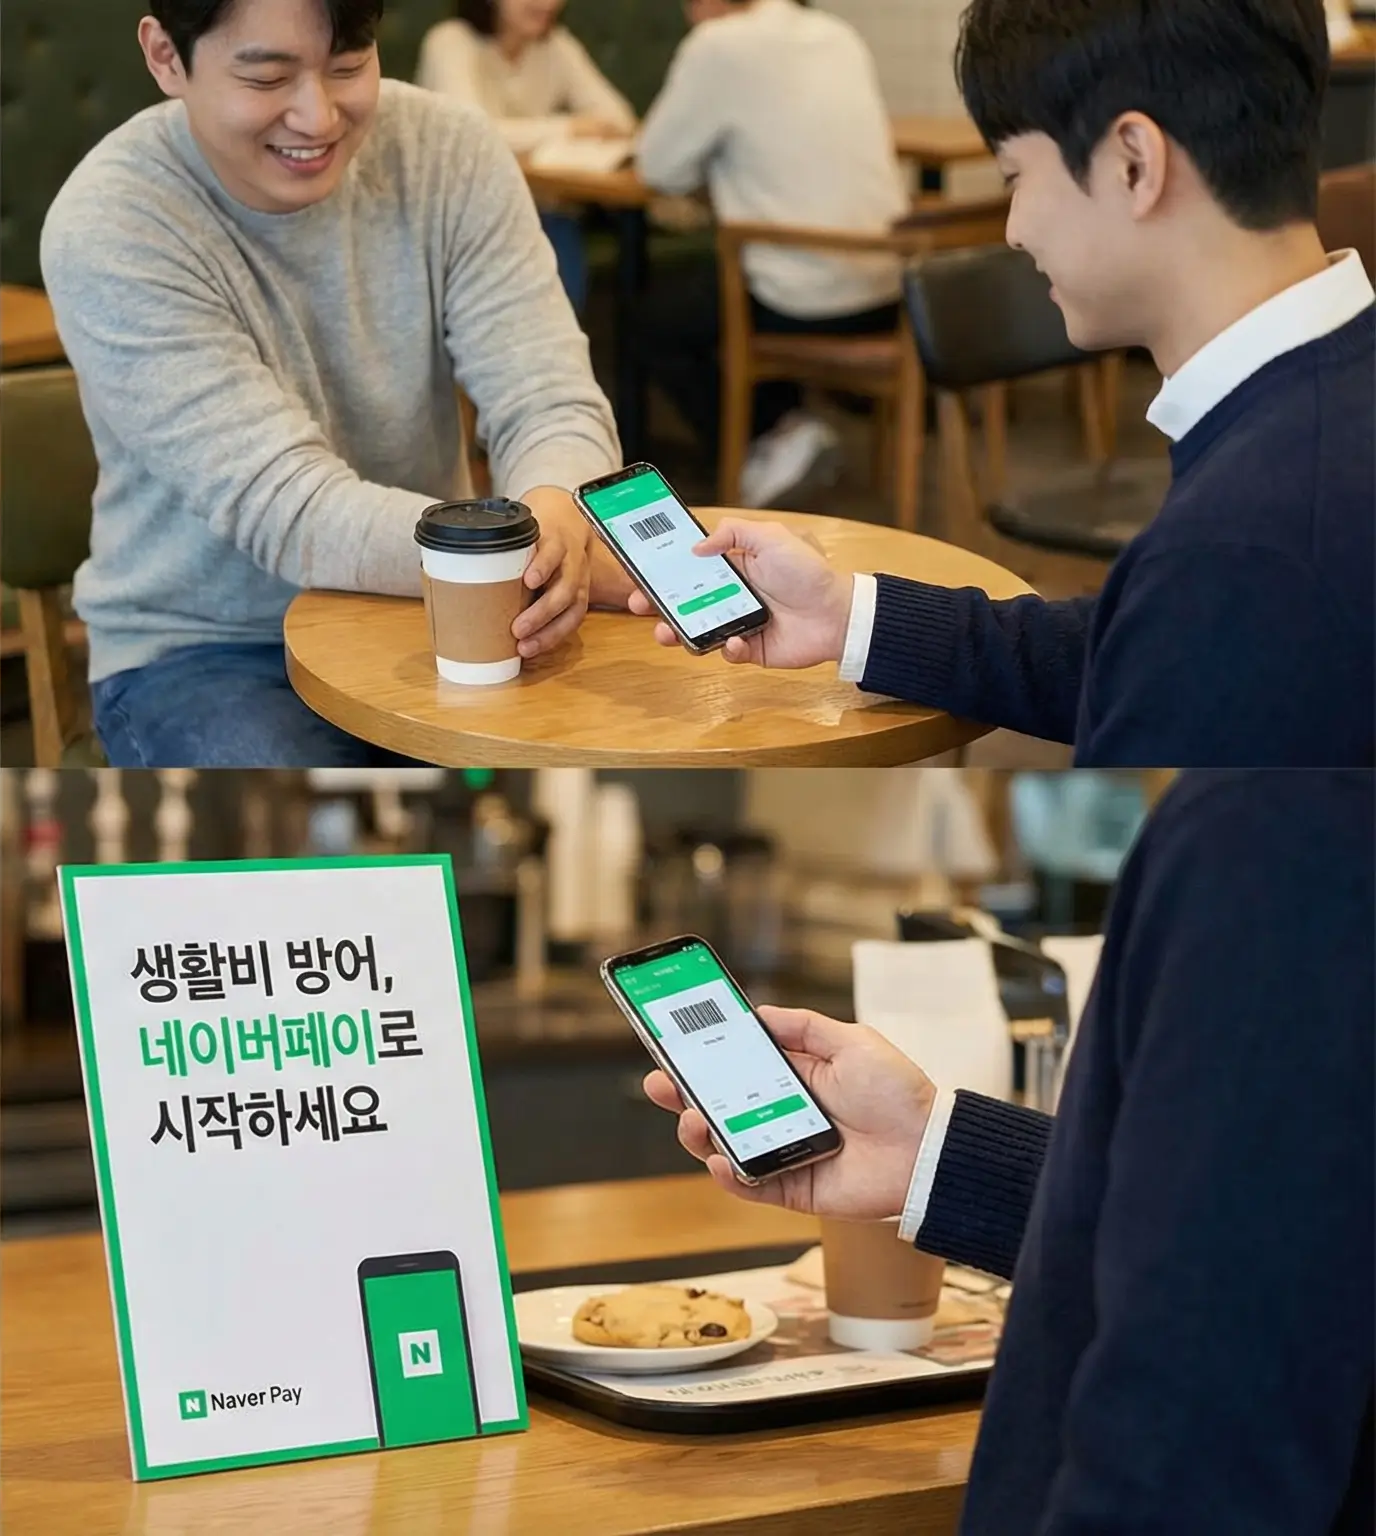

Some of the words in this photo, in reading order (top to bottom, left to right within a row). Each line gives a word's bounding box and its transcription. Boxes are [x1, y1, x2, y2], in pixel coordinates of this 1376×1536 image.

[130, 940, 274, 1003] 생활비
[285, 935, 393, 995] 방어,
[139, 1008, 423, 1077] 네이버페이로
[150, 1085, 388, 1153] 시작하세요
[410, 1342, 431, 1365] N
[210, 1391, 266, 1411] Naver
[270, 1385, 302, 1406] Pay
